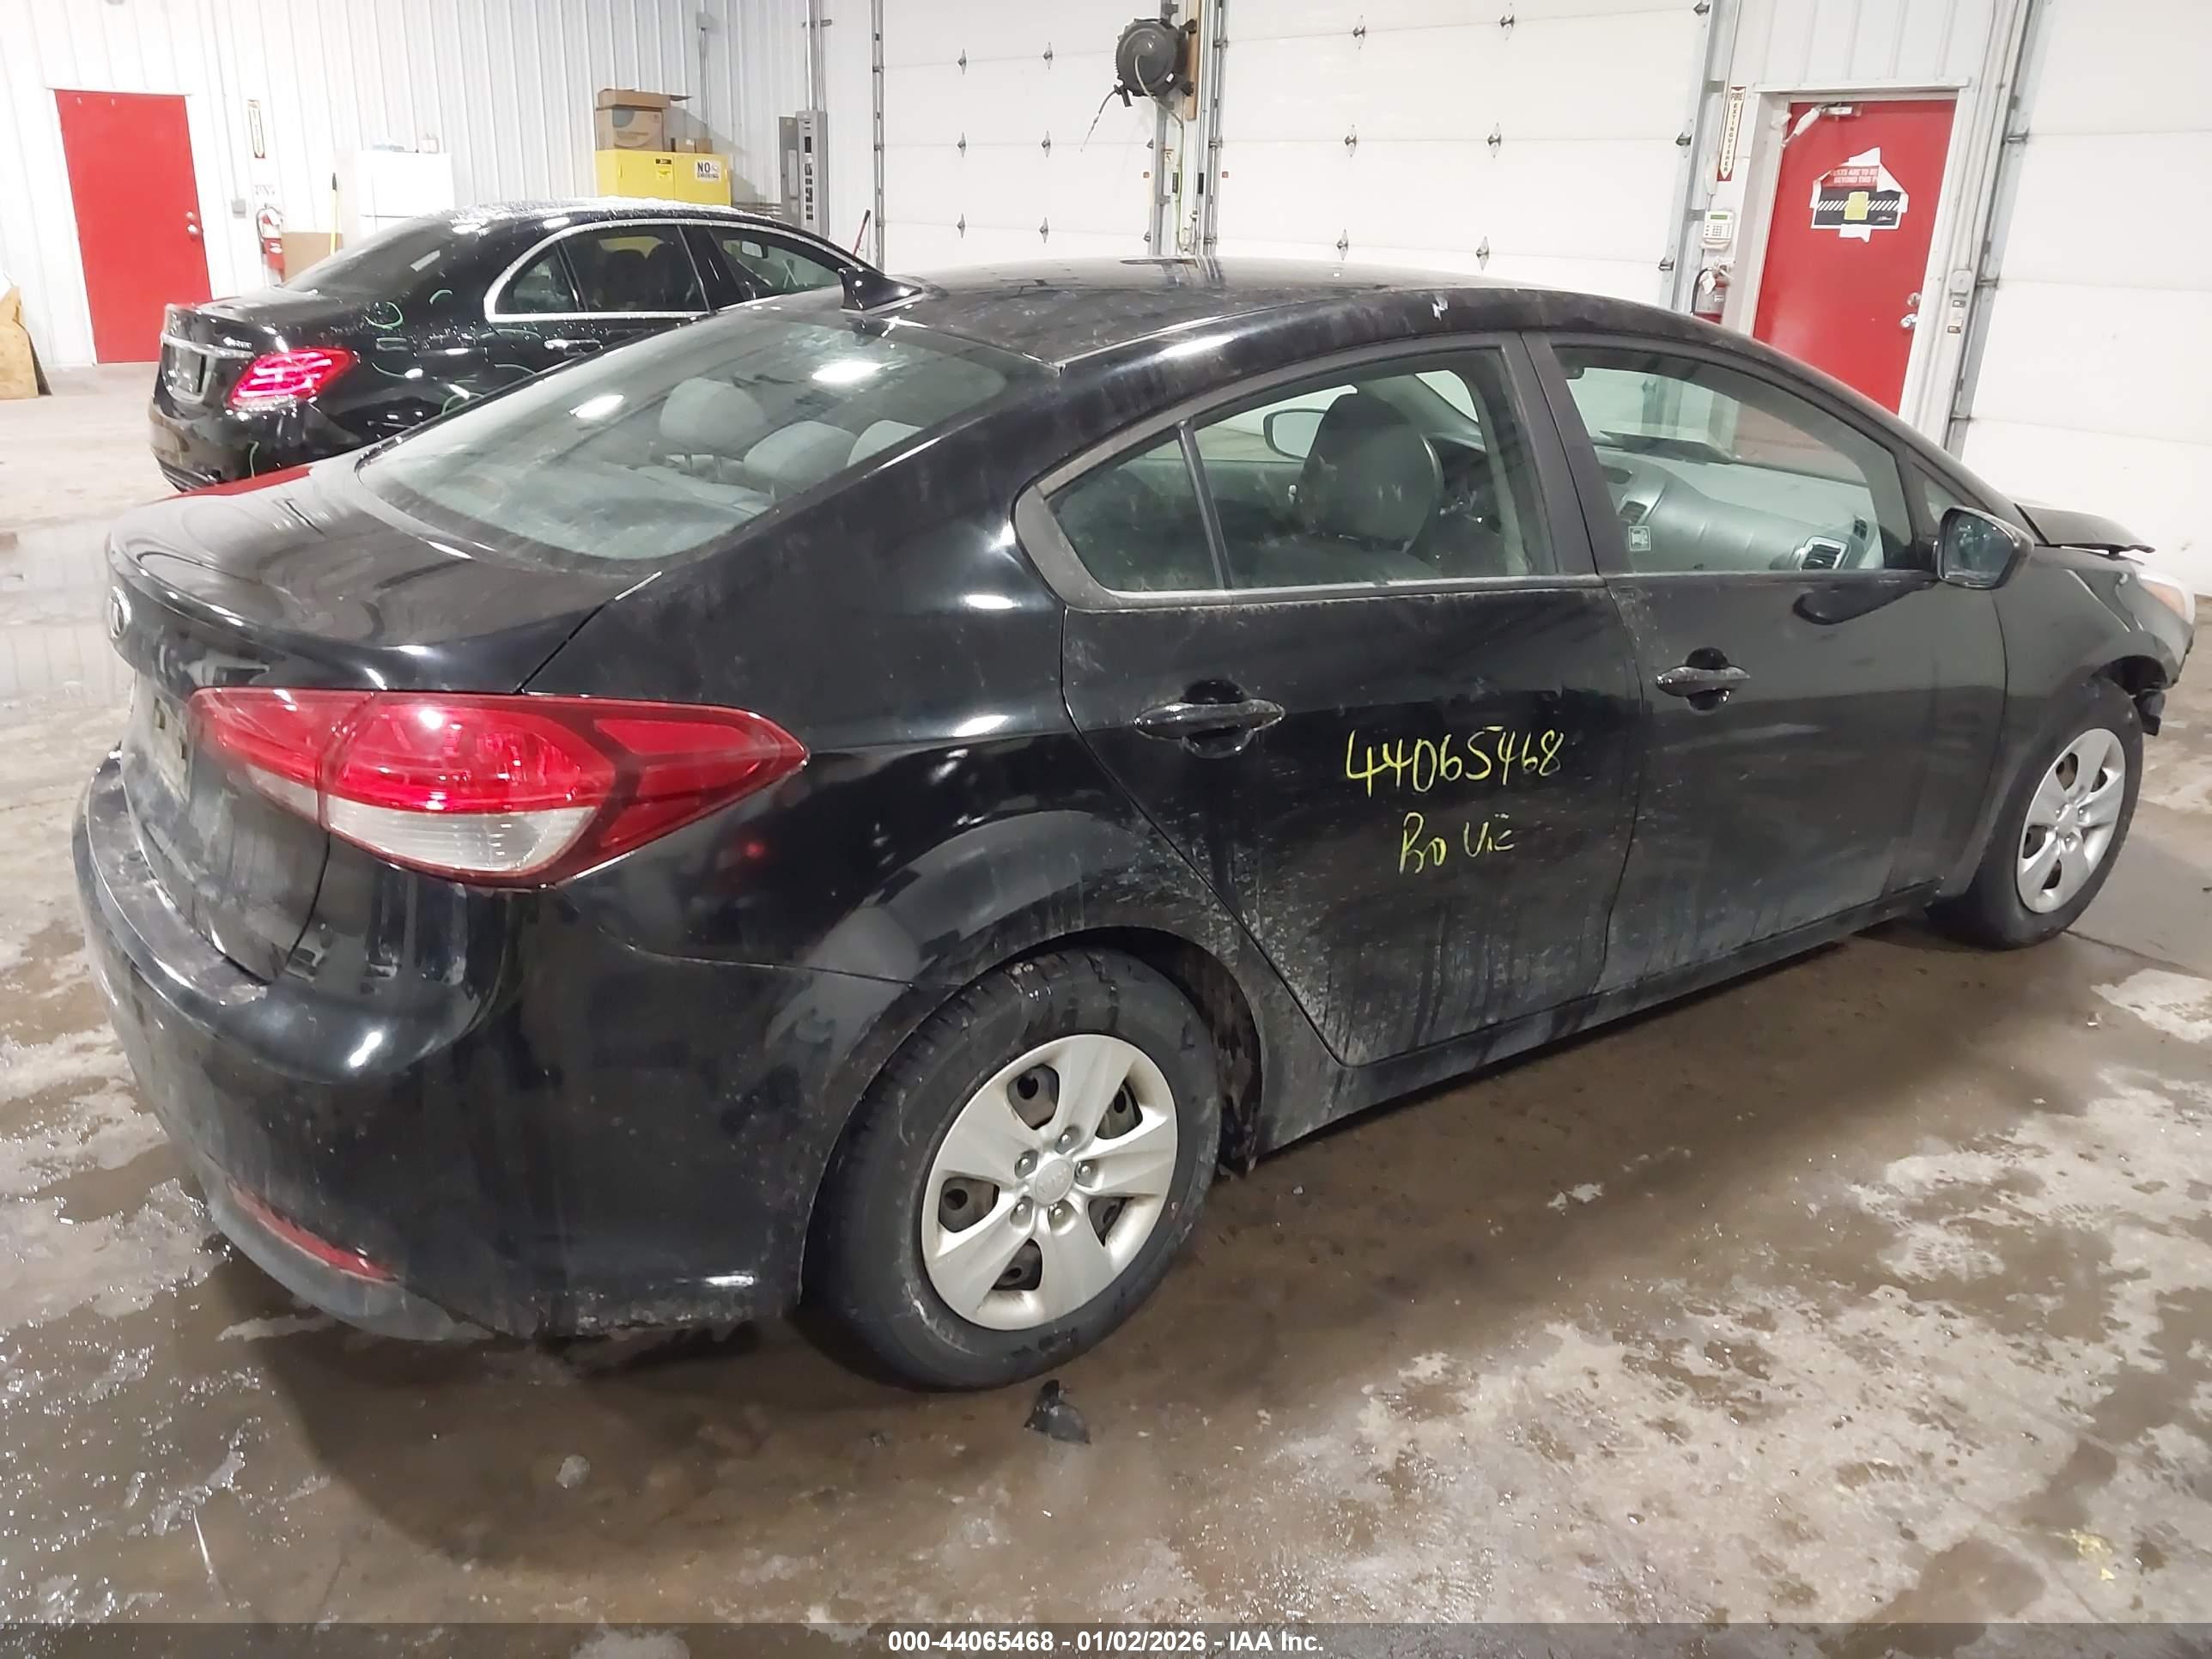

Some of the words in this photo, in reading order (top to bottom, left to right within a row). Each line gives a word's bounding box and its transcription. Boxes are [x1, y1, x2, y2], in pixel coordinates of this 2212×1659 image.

[696, 161, 711, 173] NO
[1723, 103, 1738, 172] EXTINGUISHER
[1346, 726, 1565, 797] 44065468
